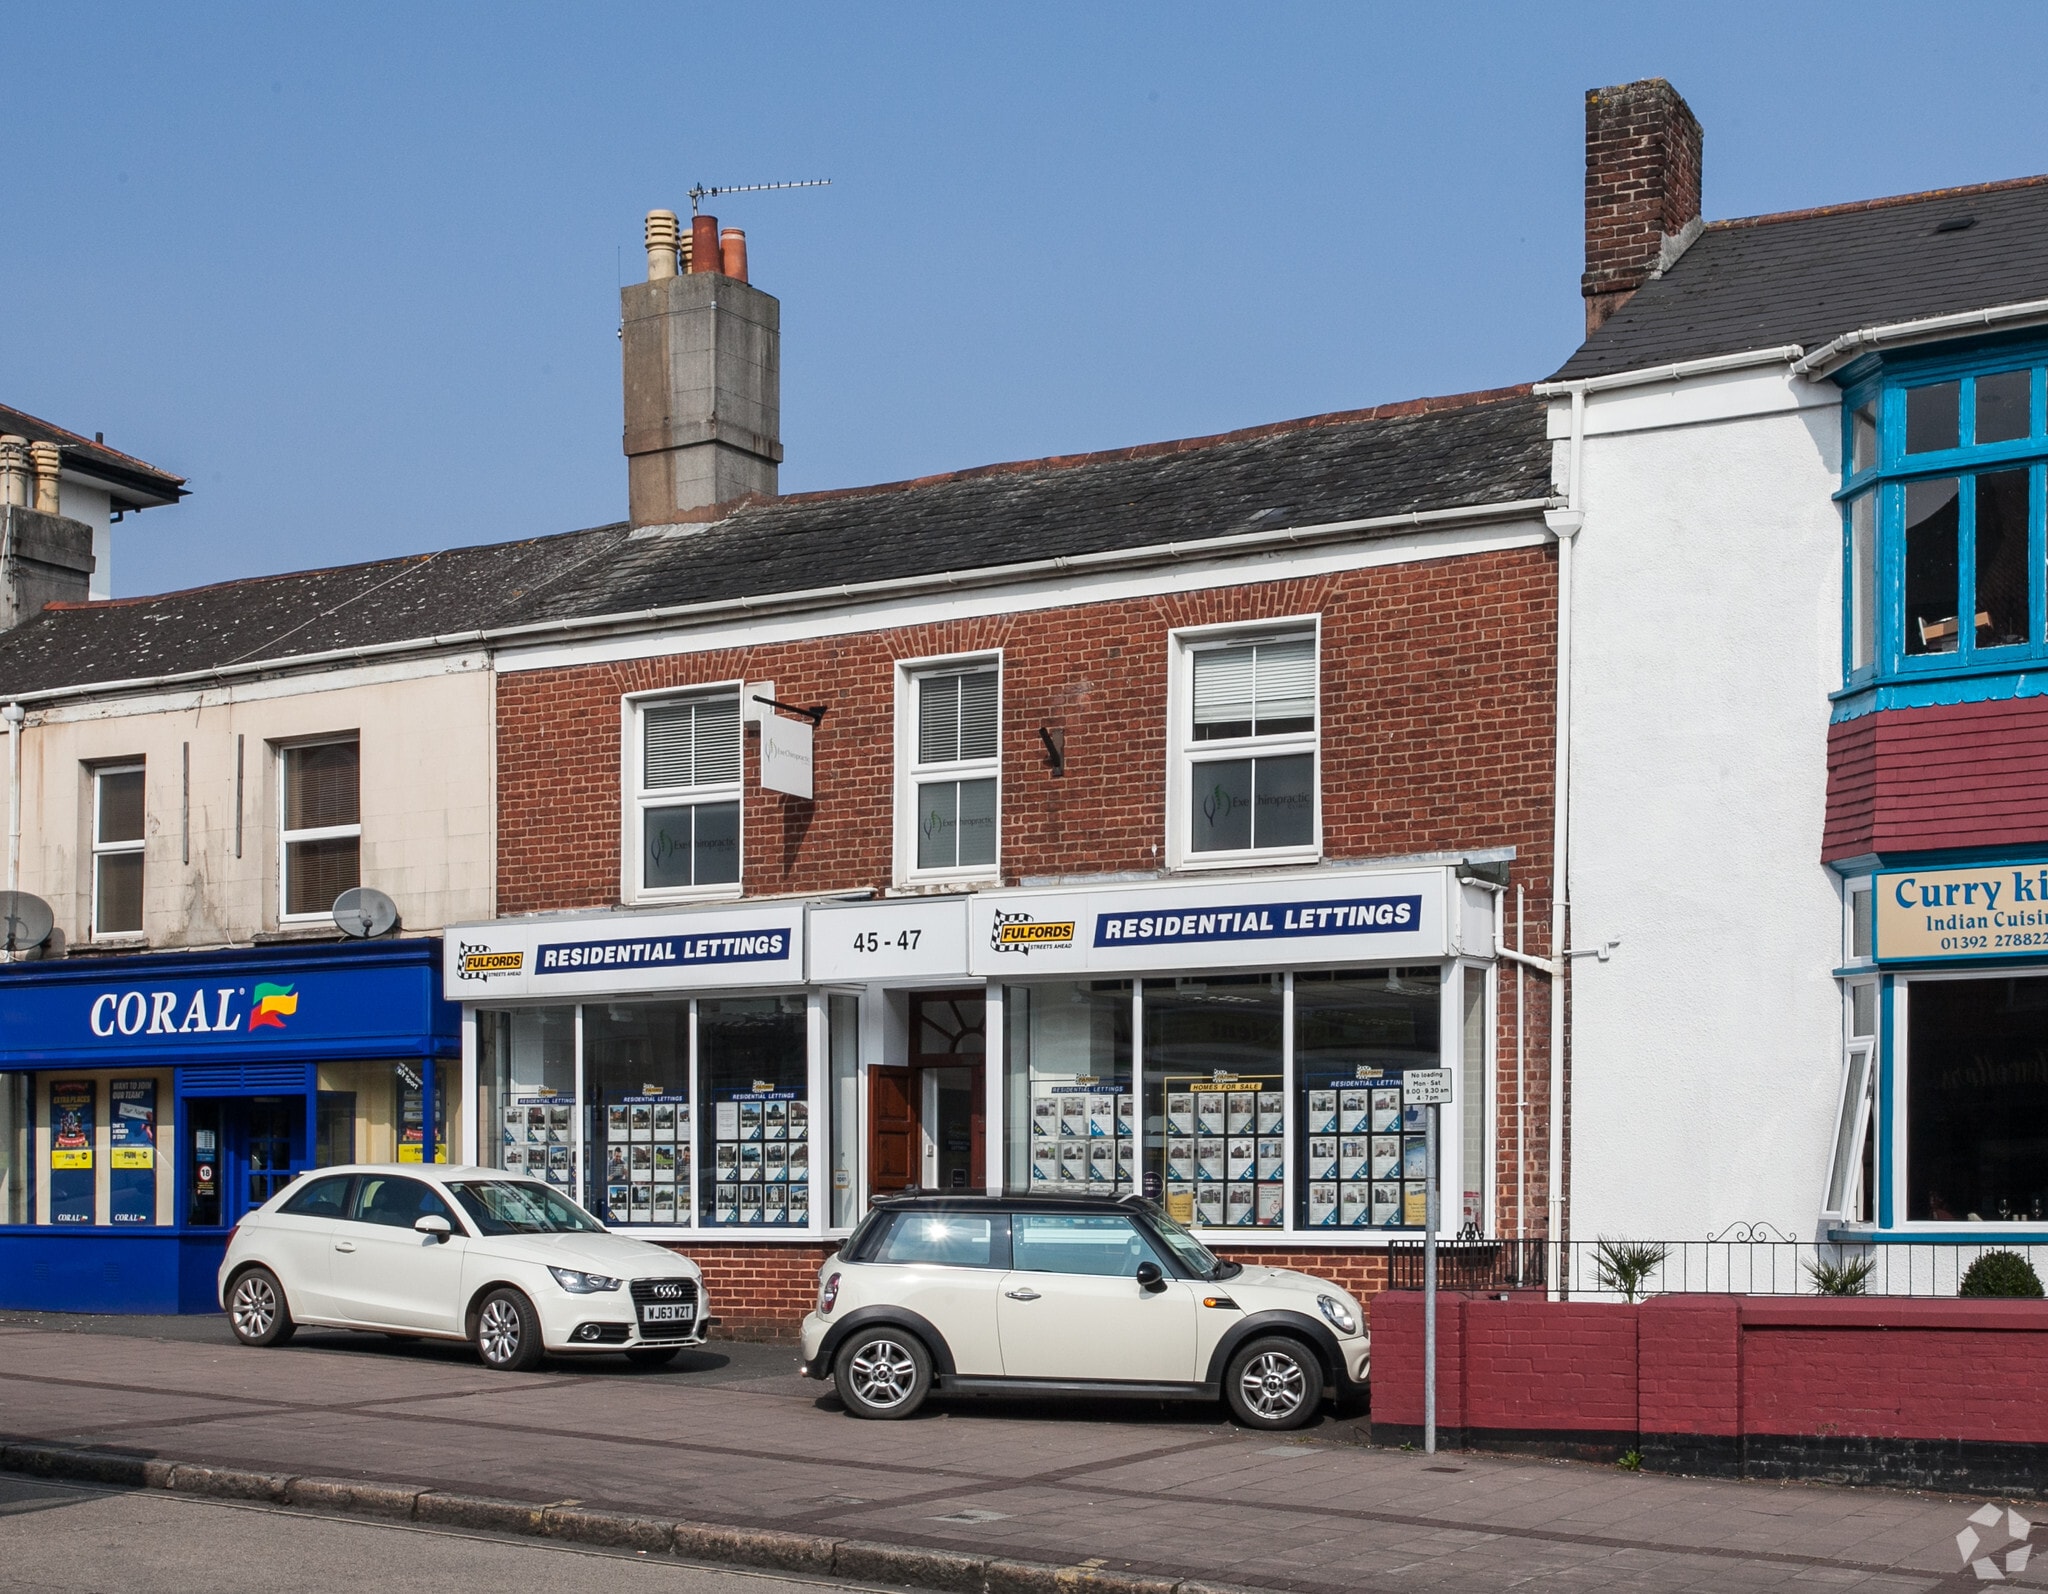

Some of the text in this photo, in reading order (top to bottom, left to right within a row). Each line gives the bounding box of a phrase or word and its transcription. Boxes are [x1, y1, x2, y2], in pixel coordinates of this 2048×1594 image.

[1895, 870, 2048, 910] Curry ki
[1105, 901, 1412, 940] RESIDENTIAL LETTINGS
[1926, 913, 1988, 931] Indian
[1003, 926, 1071, 939] FULFORDS
[853, 932, 878, 953] 45
[897, 929, 922, 950] 47
[1941, 932, 2048, 950] 01392 278822
[543, 934, 783, 968] RESIDENTIAL LETTINGS
[467, 955, 520, 968] FULFORDS
[90, 987, 241, 1037] CORAL
[1034, 1124, 1043, 1133] LET
[1062, 1124, 1071, 1133] LET
[1091, 1123, 1101, 1133] LET
[1326, 1120, 1335, 1130] LET
[1357, 1120, 1367, 1130] LET
[1389, 1119, 1399, 1130] LET
[202, 1168, 211, 1177] 18
[1034, 1168, 1043, 1178] LET
[1168, 1167, 1178, 1177] LET
[1199, 1167, 1208, 1177] LET
[1244, 1168, 1253, 1178] LET
[1273, 1167, 1282, 1178] LET
[1326, 1167, 1336, 1178] LET
[1357, 1166, 1367, 1177] LET
[1389, 1166, 1399, 1177] LET
[57, 1214, 81, 1222] CORAL
[114, 1214, 138, 1222] CORAL
[1243, 1213, 1252, 1222] LET
[1326, 1212, 1336, 1223] LET
[1357, 1212, 1367, 1223] LET
[1389, 1212, 1399, 1222] LET
[648, 1307, 672, 1320] WJ63
